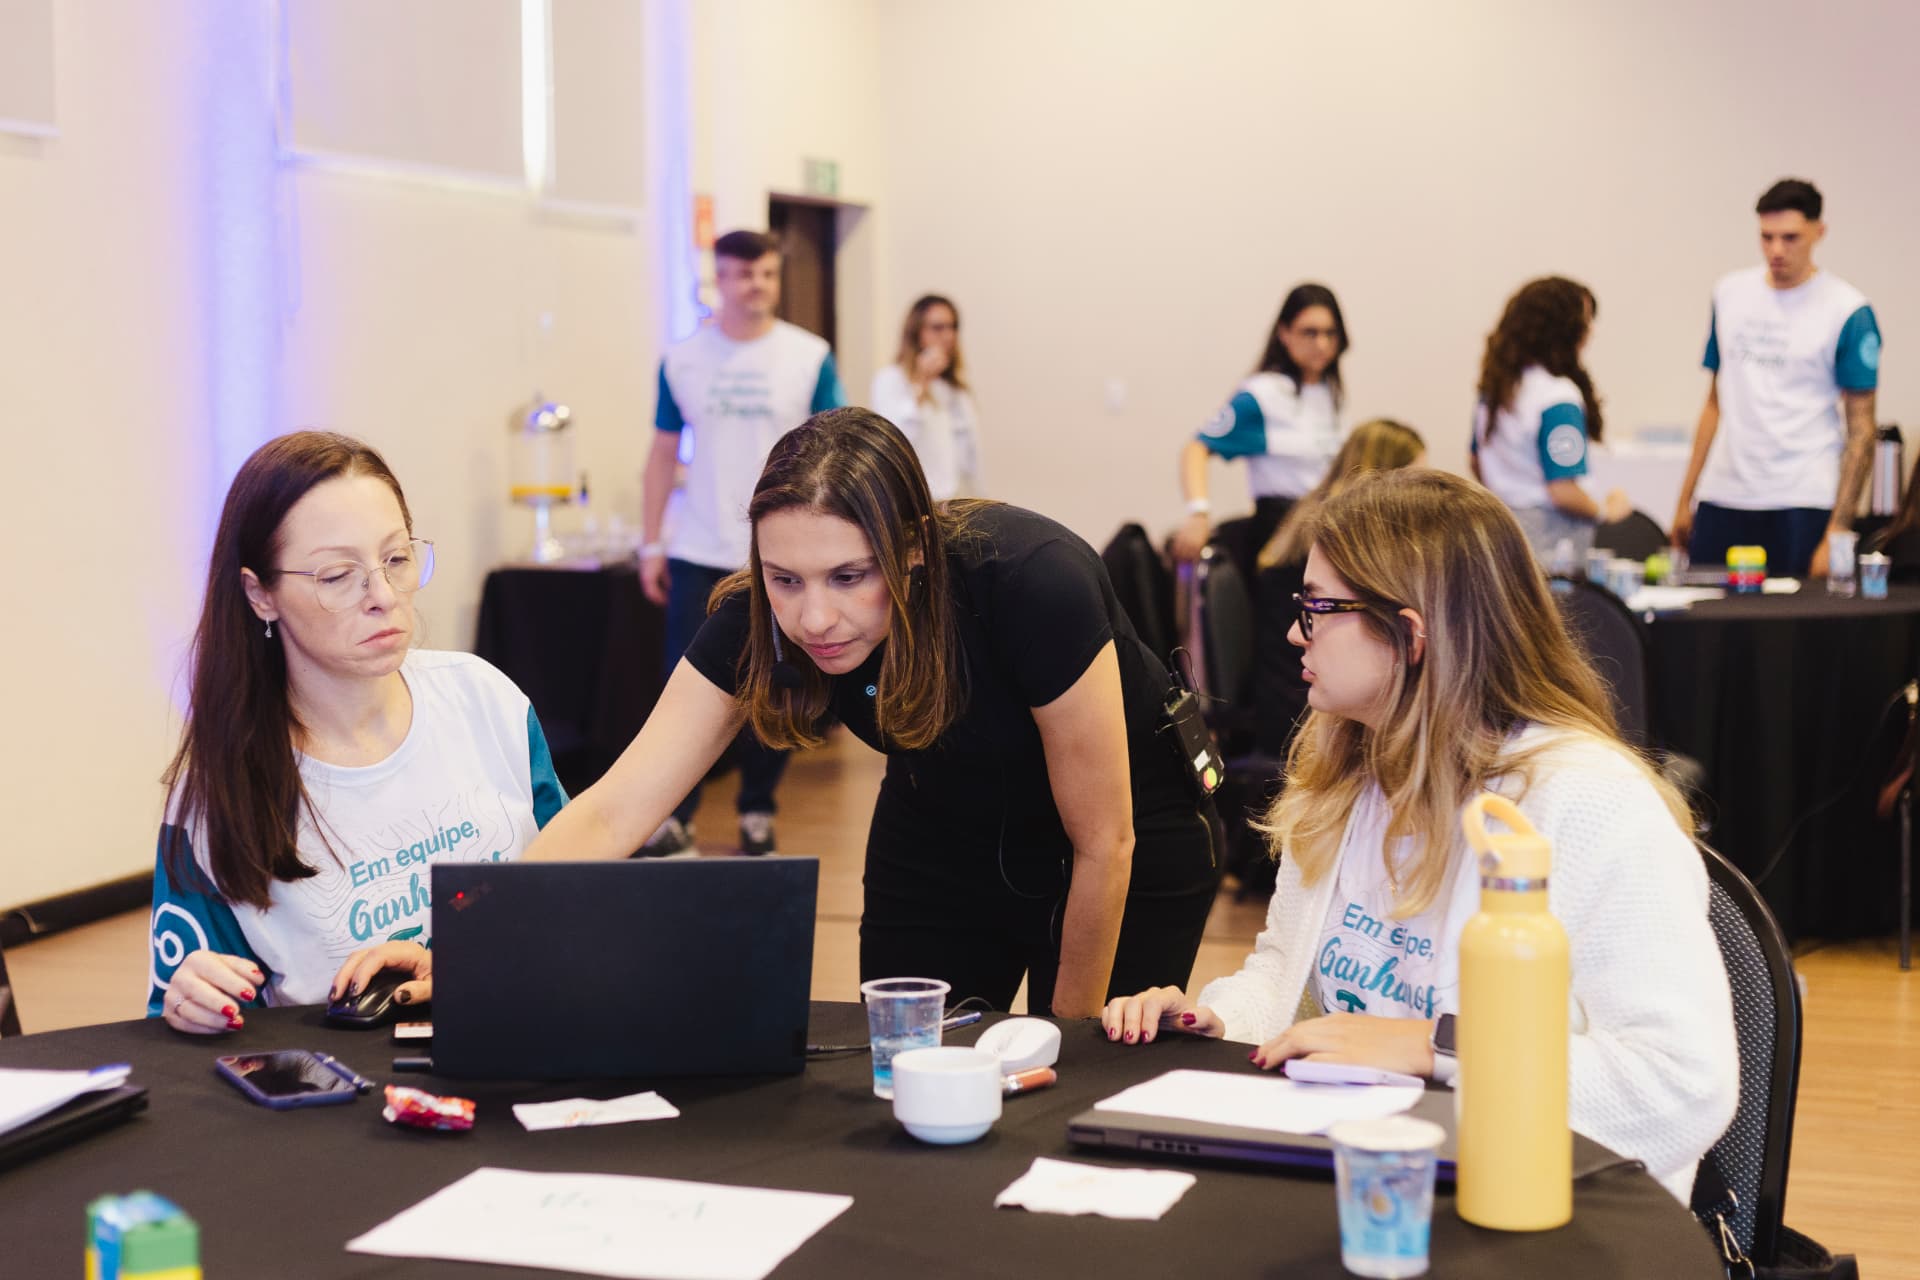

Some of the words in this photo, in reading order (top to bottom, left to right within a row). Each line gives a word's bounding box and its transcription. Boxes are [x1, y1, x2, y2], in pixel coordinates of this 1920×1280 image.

[351, 858, 390, 888] Em
[397, 821, 479, 867] equipe,
[349, 872, 432, 942] Ganh
[1343, 903, 1383, 937] Em
